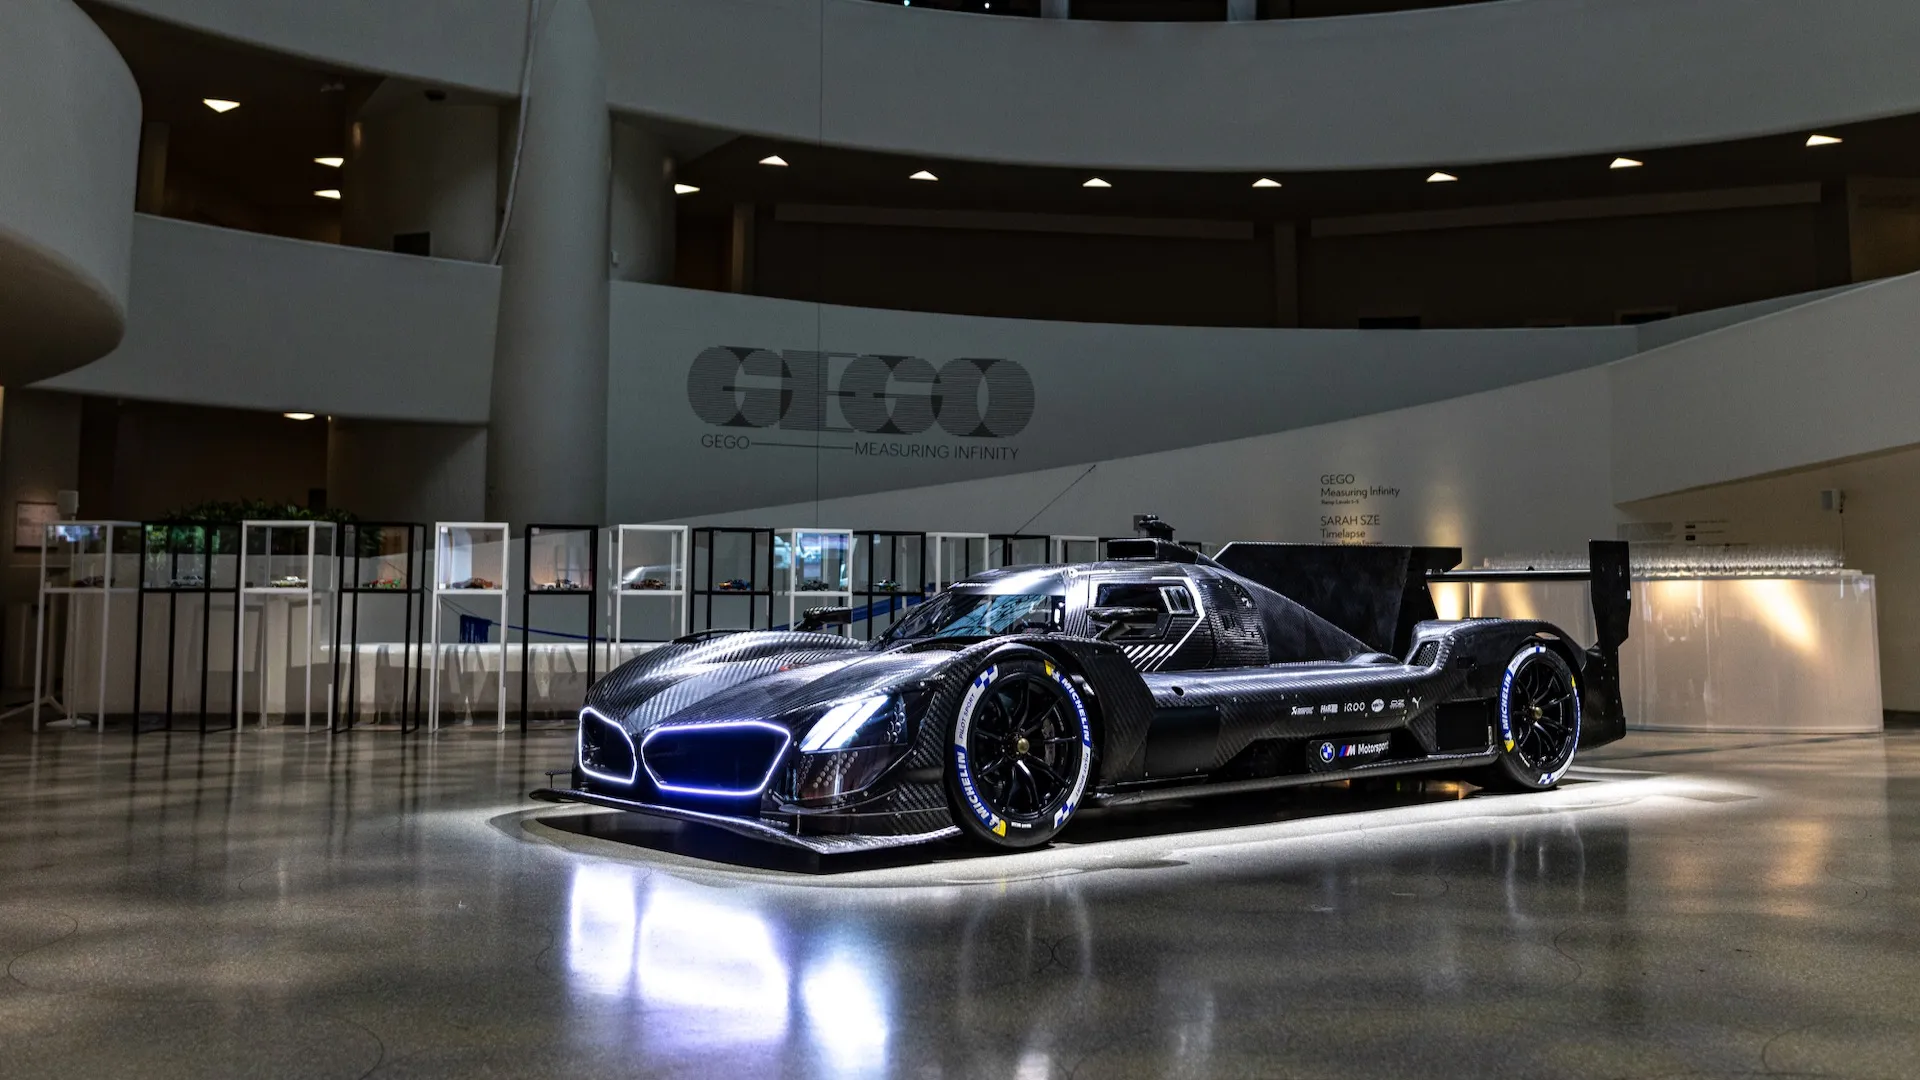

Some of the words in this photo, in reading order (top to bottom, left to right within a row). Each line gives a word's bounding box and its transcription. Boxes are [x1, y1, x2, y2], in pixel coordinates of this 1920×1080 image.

[701, 434, 750, 451] GEGO
[854, 441, 949, 459] MEASURING
[954, 445, 1019, 460] INFINITY
[1320, 474, 1354, 484] GEGO
[1320, 488, 1368, 499] Measuring
[1370, 485, 1400, 498] Infinity
[1320, 516, 1358, 526] SARAH
[1360, 515, 1380, 526] SZE
[1320, 528, 1366, 539] Timelapse
[1062, 678, 1090, 742] MICHELIN
[1502, 673, 1512, 731] MICHELIN
[959, 719, 967, 740] PILOT
[964, 693, 976, 718] SPORT
[1358, 740, 1389, 755] Motorsport
[956, 752, 989, 820] MICHELIN
